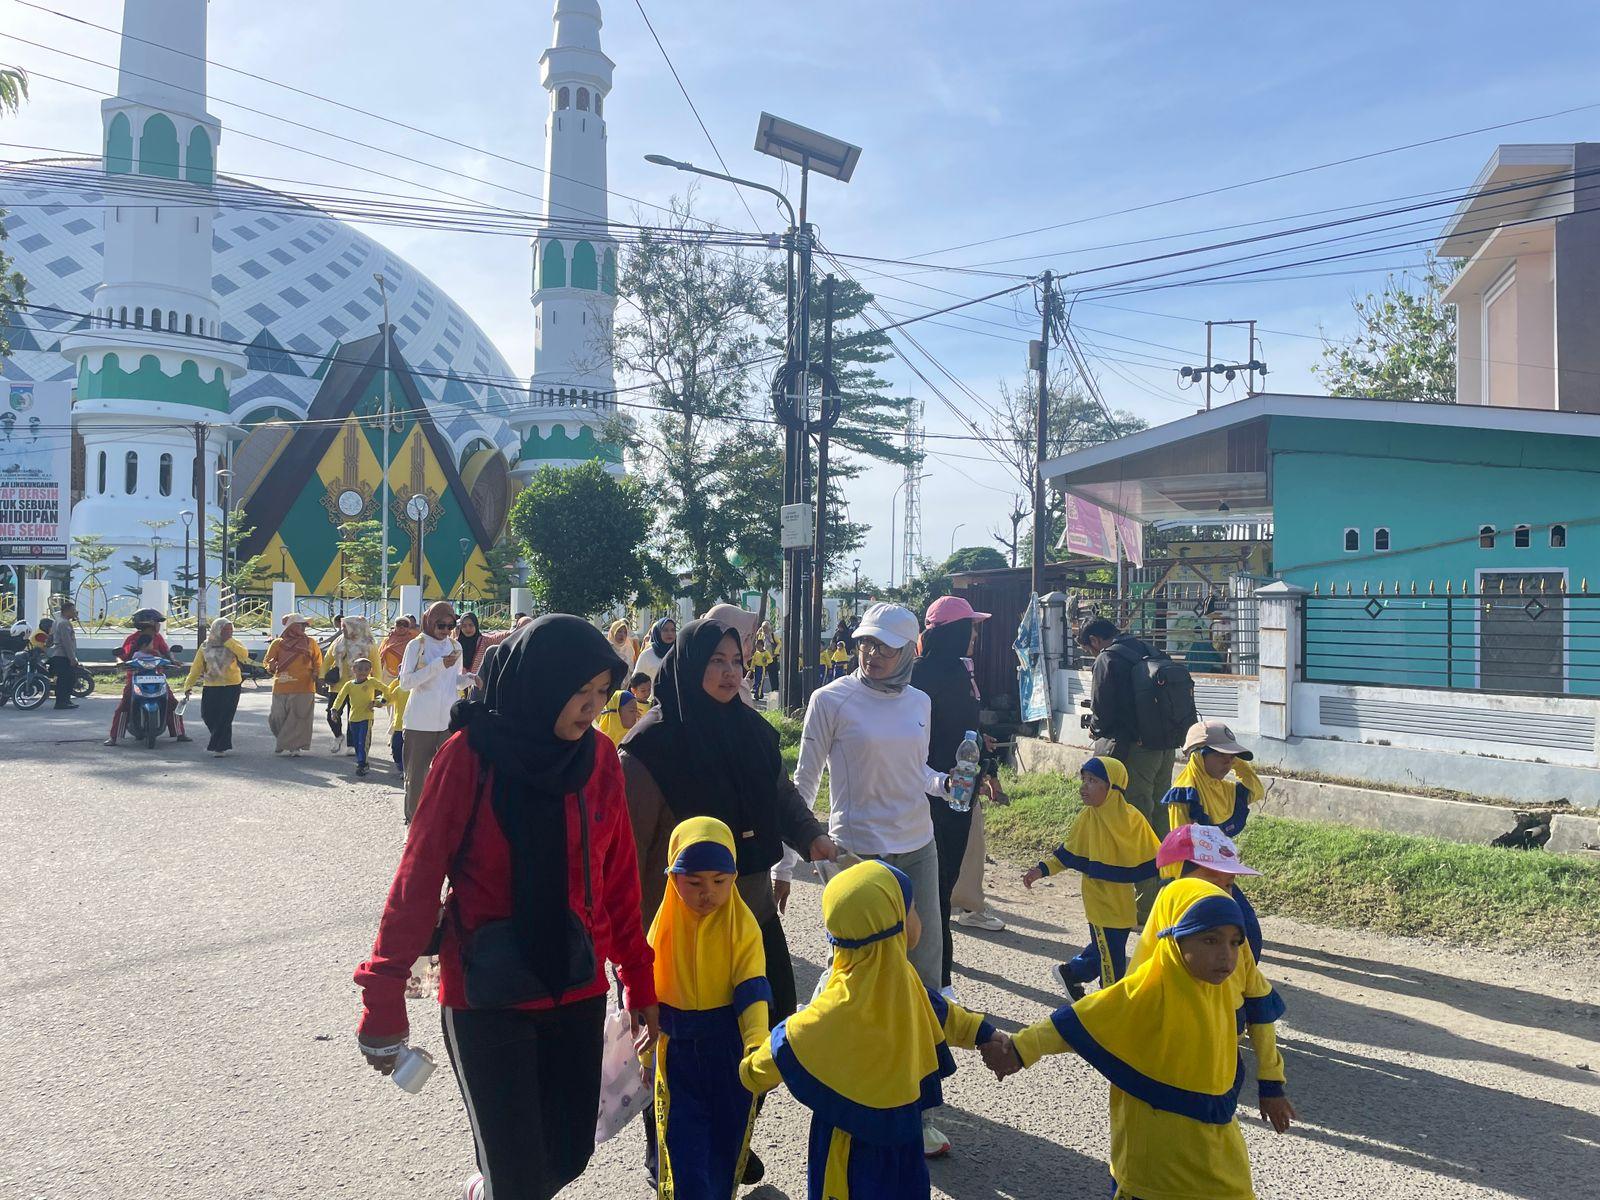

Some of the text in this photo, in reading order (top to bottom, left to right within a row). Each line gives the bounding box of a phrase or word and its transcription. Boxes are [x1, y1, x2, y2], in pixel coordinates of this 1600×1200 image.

[18, 489, 58, 499] BERSIH
[18, 499, 59, 510] SEBUAH
[0, 510, 59, 524] HIDUPAN
[19, 524, 58, 536] SEHAT
